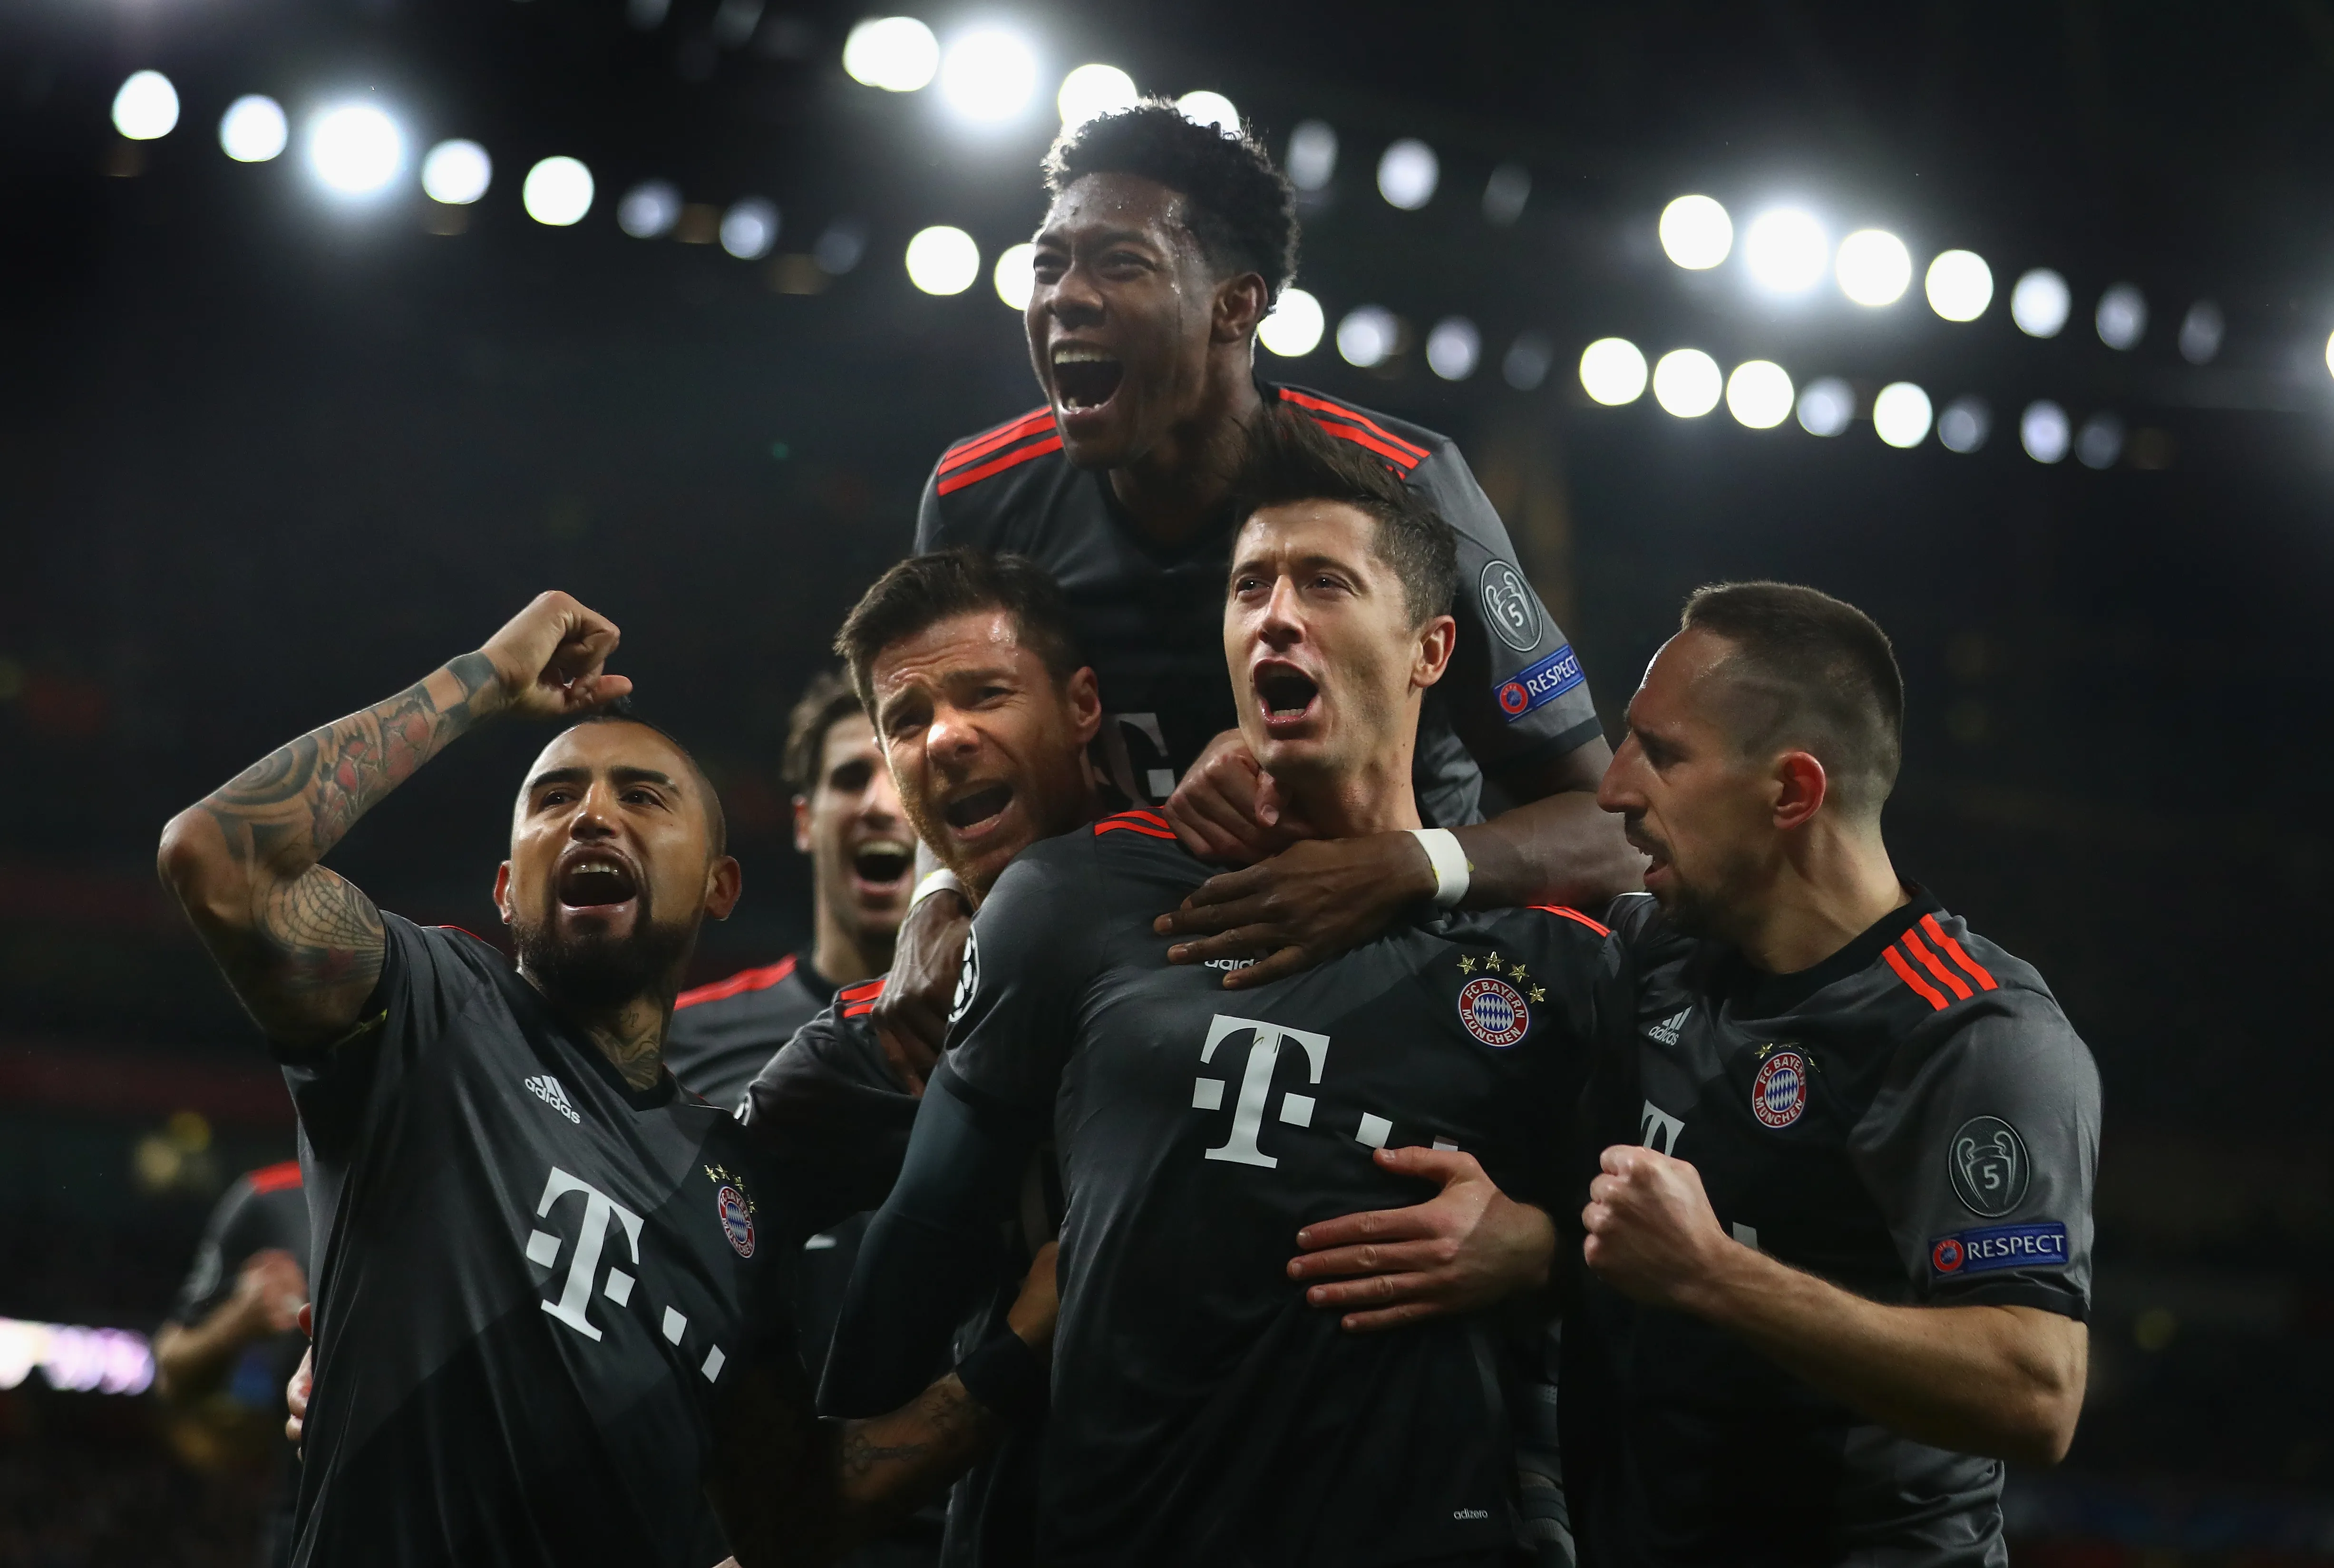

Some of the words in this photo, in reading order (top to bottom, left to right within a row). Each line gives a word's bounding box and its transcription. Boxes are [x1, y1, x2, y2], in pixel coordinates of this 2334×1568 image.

[1507, 602, 1523, 627] 5
[1526, 655, 1578, 697] RESPECT
[1465, 984, 1480, 1000] FC
[1481, 981, 1526, 1019] BAYERN
[1462, 1009, 1522, 1043] MÜNCHEN
[1648, 1025, 1680, 1046] adidas
[1759, 1066, 1772, 1084] FC
[1773, 1056, 1805, 1086] BAYERN
[525, 1078, 581, 1124] adidas
[1200, 1013, 1331, 1169] T
[1983, 1164, 2001, 1190] 5
[536, 1166, 645, 1343] T
[1966, 1234, 2065, 1260] RESPECT
[1453, 1508, 1488, 1520] adizero
